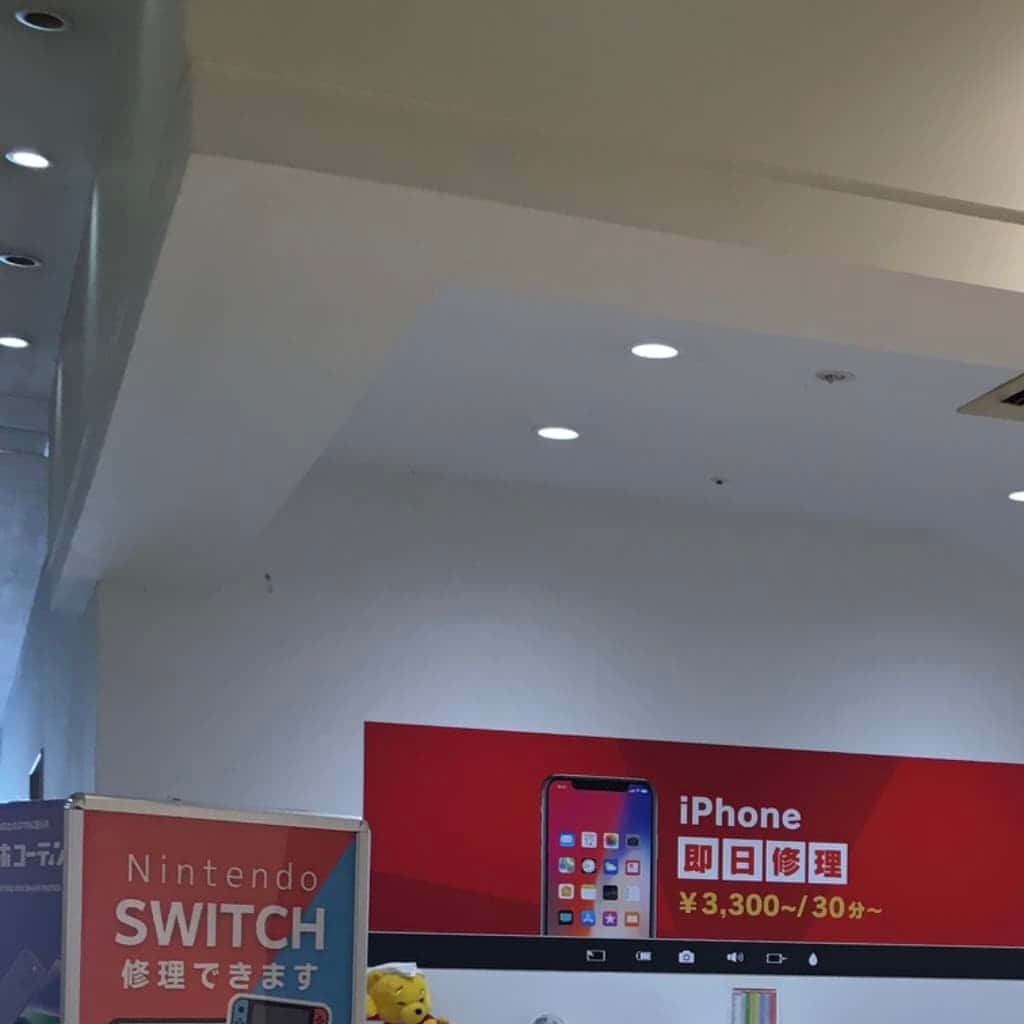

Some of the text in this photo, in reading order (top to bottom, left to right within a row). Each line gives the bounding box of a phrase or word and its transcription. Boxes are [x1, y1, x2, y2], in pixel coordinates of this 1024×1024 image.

[680, 796, 801, 830] iPhone
[127, 854, 319, 892] Nintendo
[681, 840, 844, 881] 即日修理
[115, 899, 325, 951] SWITCH
[121, 961, 319, 991] 修理できます
